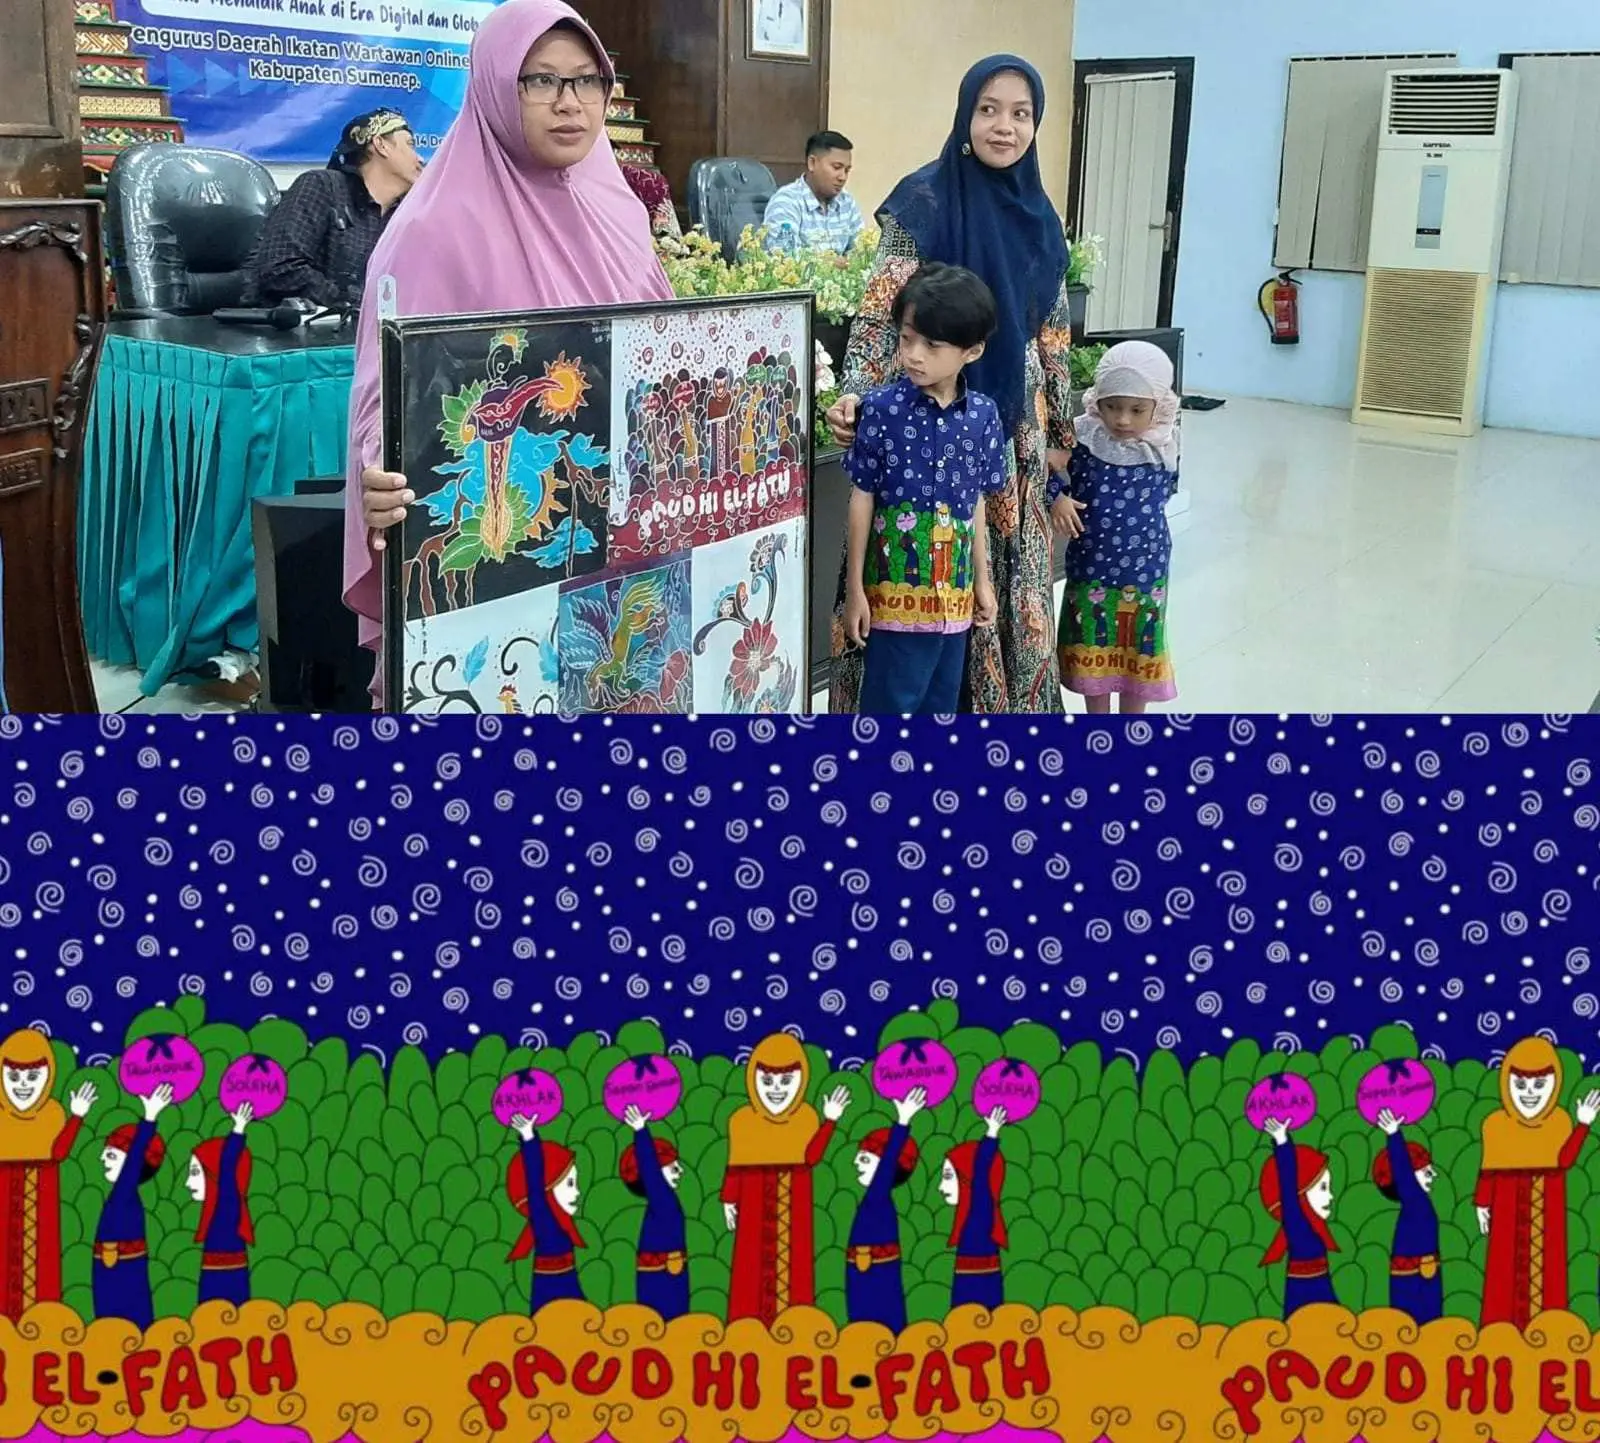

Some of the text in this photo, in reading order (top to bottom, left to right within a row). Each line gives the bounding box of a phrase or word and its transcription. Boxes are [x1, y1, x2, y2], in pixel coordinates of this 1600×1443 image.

[289, 0, 325, 16] Anak
[331, 1, 345, 18] di
[350, 3, 374, 21] Era
[380, 5, 423, 31] Digital
[427, 11, 449, 29] dan
[128, 24, 470, 68] engurus Daerah Ikatan Wartawan Online
[250, 60, 421, 91] Kabupaten Sumenep.
[415, 134, 428, 147] 14
[700, 491, 718, 515] HI
[723, 469, 790, 510] EL-FATH
[32, 1333, 298, 1418] EL-FATH
[467, 1336, 1051, 1432] PAUD HI EL-FATH
[1219, 1348, 1427, 1435] PAUD
[1445, 1354, 1514, 1415] HI
